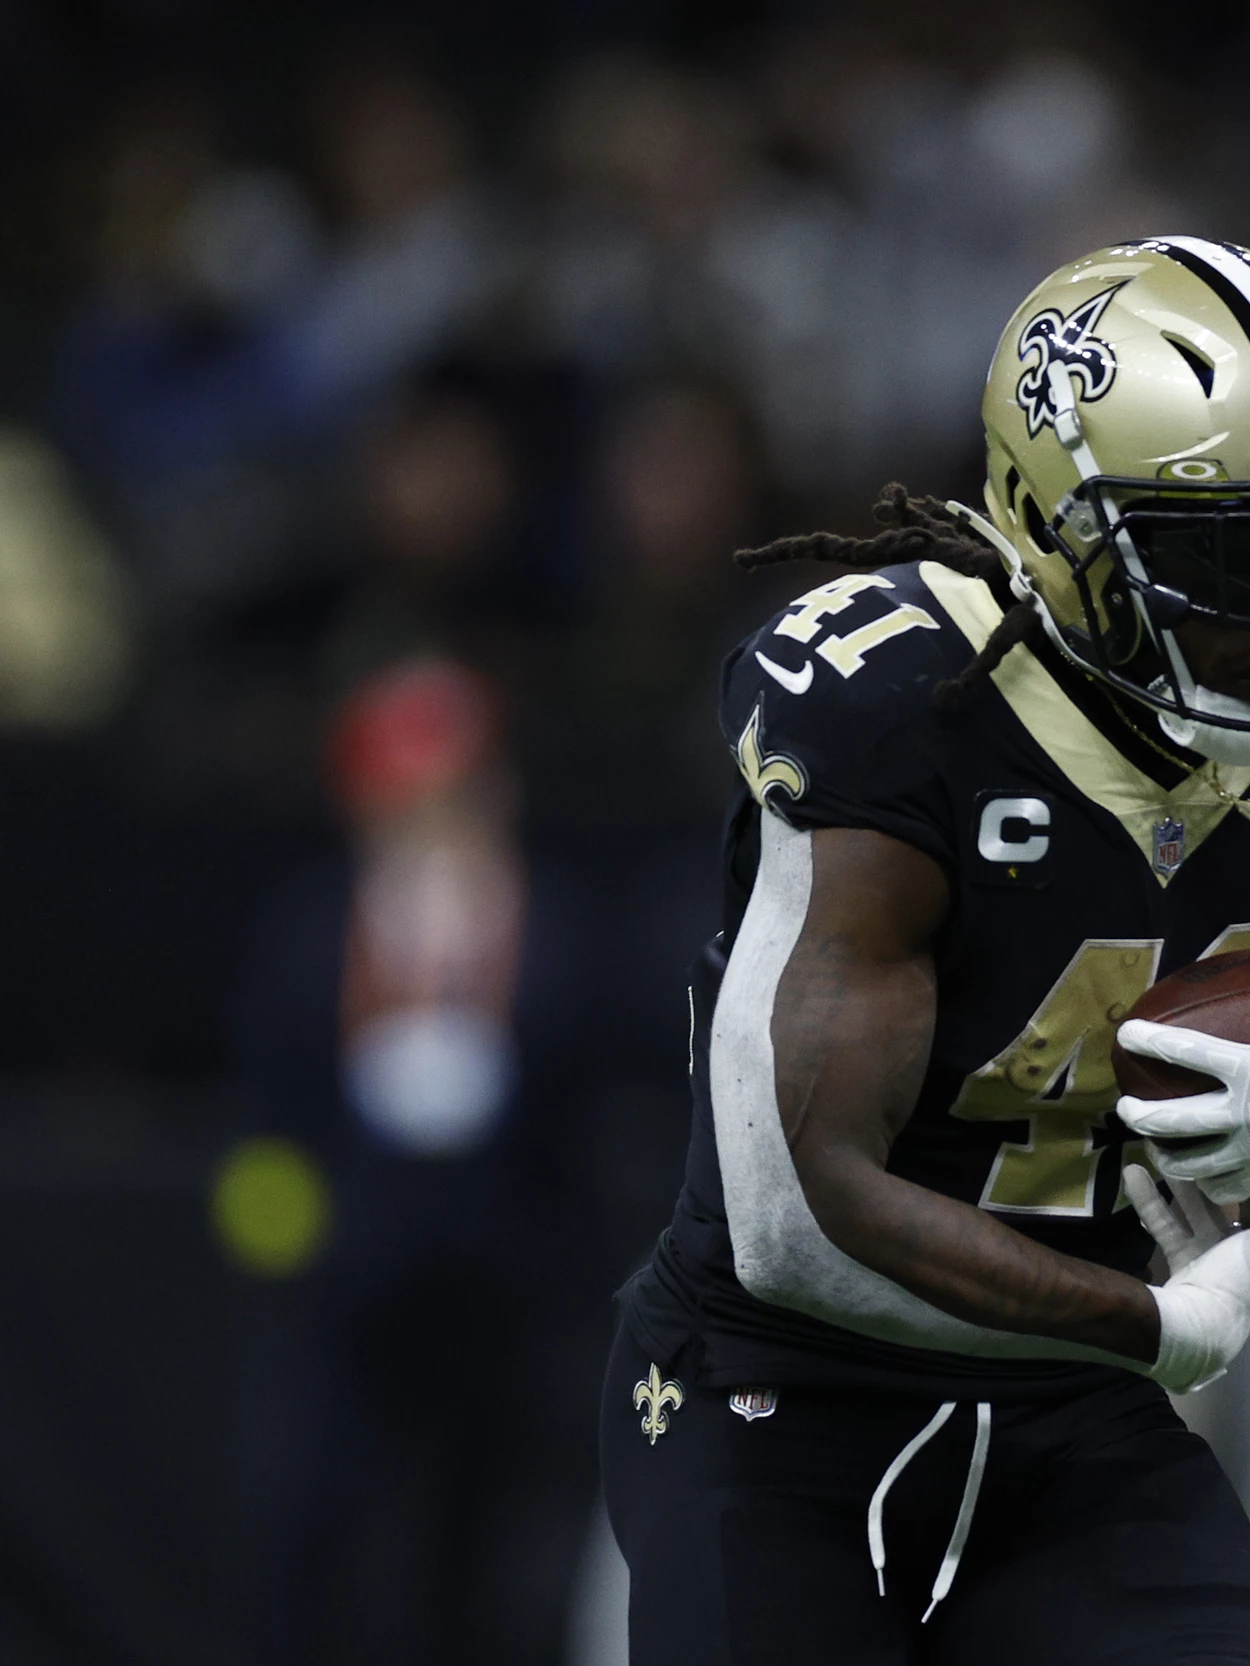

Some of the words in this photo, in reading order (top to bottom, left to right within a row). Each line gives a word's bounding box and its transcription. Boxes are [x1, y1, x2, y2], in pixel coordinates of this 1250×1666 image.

[774, 574, 941, 679] 41
[978, 798, 1051, 862] C
[737, 1387, 769, 1410] NFL
